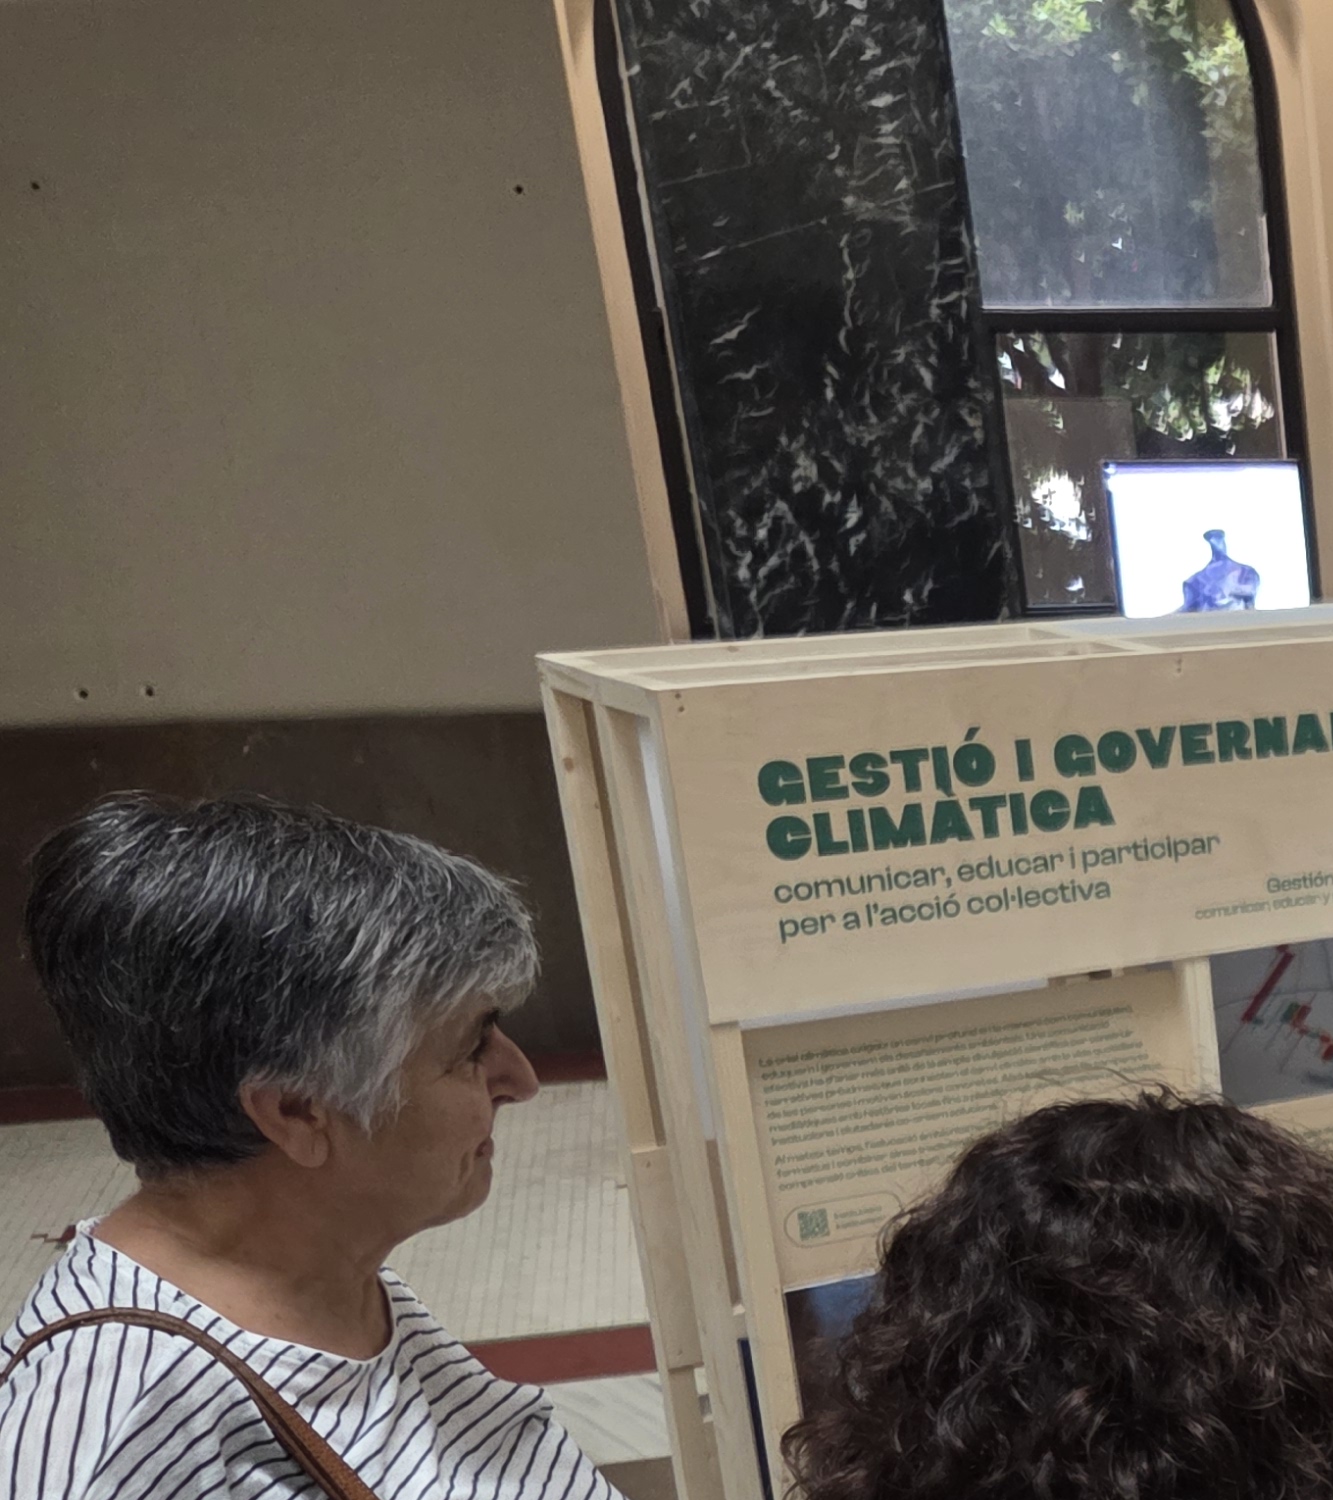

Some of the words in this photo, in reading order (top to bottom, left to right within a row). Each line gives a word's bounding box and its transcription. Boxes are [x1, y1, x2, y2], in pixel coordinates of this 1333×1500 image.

[758, 726, 996, 806] GESTIÓ
[1014, 738, 1034, 782] I
[766, 786, 1115, 860] CLIMÀTICA
[774, 866, 951, 903] comunicar,
[957, 855, 1063, 882] educar
[1083, 834, 1221, 872] participar
[779, 911, 836, 944] per
[843, 909, 861, 930] a
[967, 879, 1111, 915] col·lectiva
